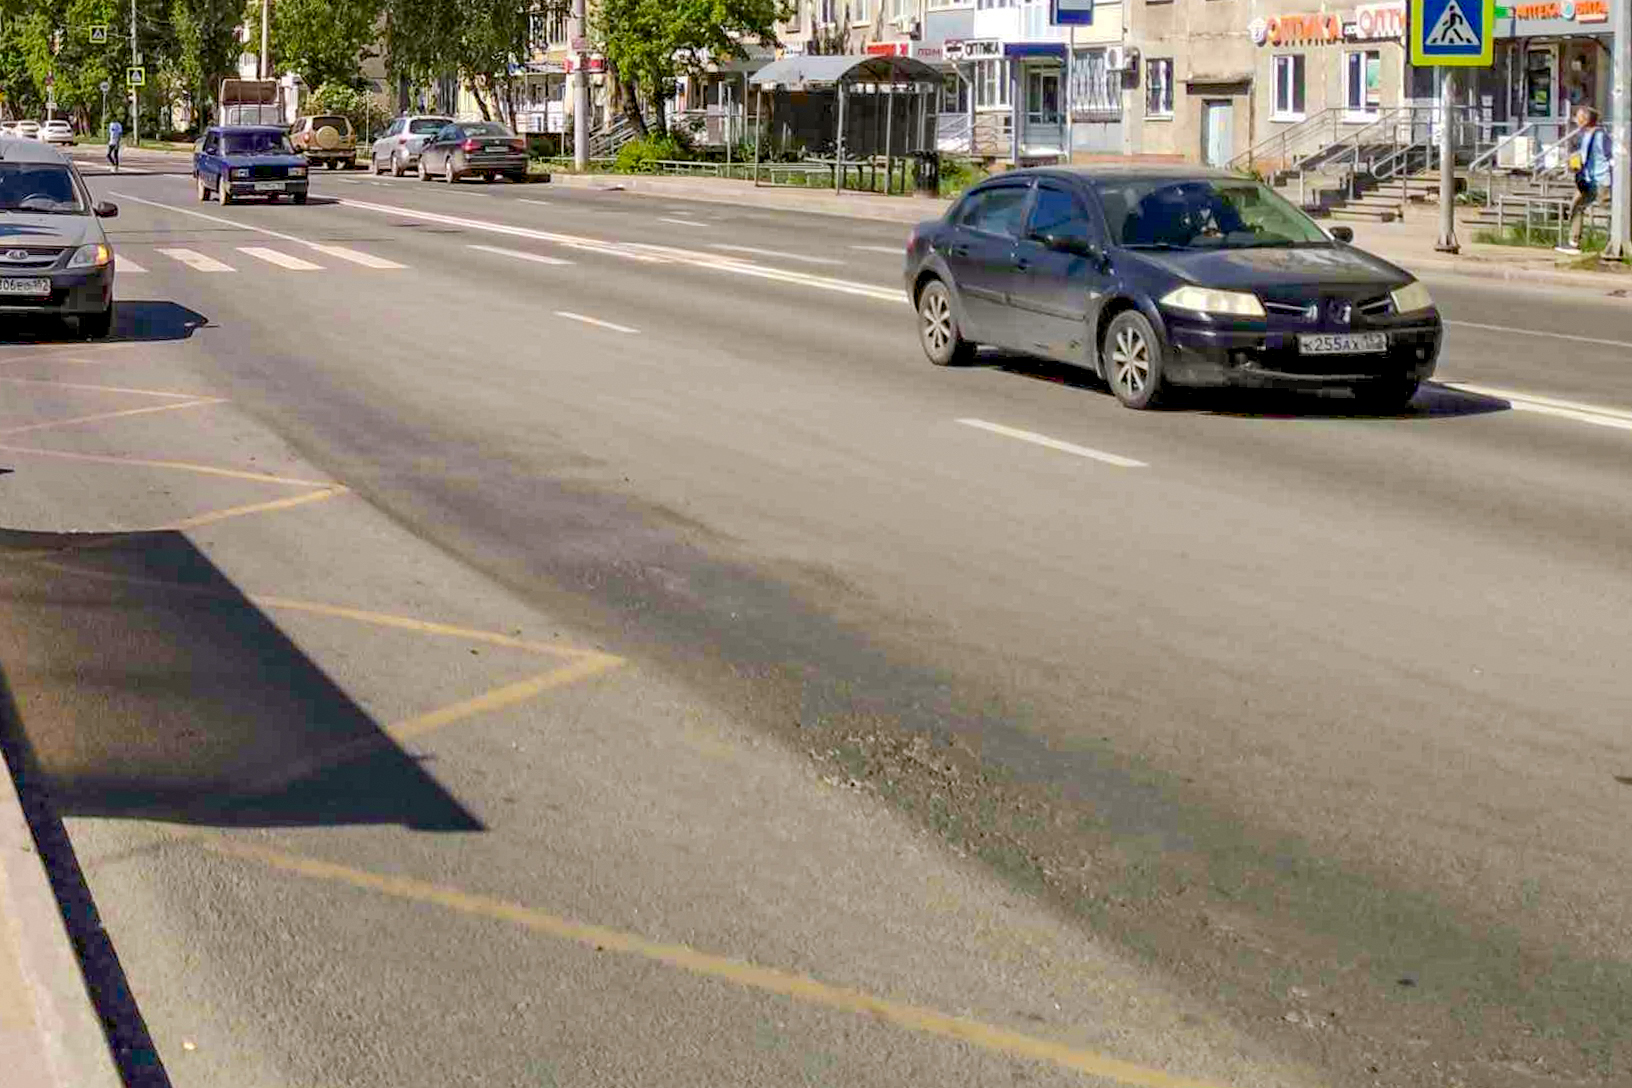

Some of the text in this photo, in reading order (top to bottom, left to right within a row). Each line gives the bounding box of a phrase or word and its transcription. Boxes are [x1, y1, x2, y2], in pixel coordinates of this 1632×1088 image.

[1516, 3, 1561, 21] АПТЕКА
[1267, 13, 1344, 48] ОПТИКА
[965, 40, 1001, 58] ОПТИКА
